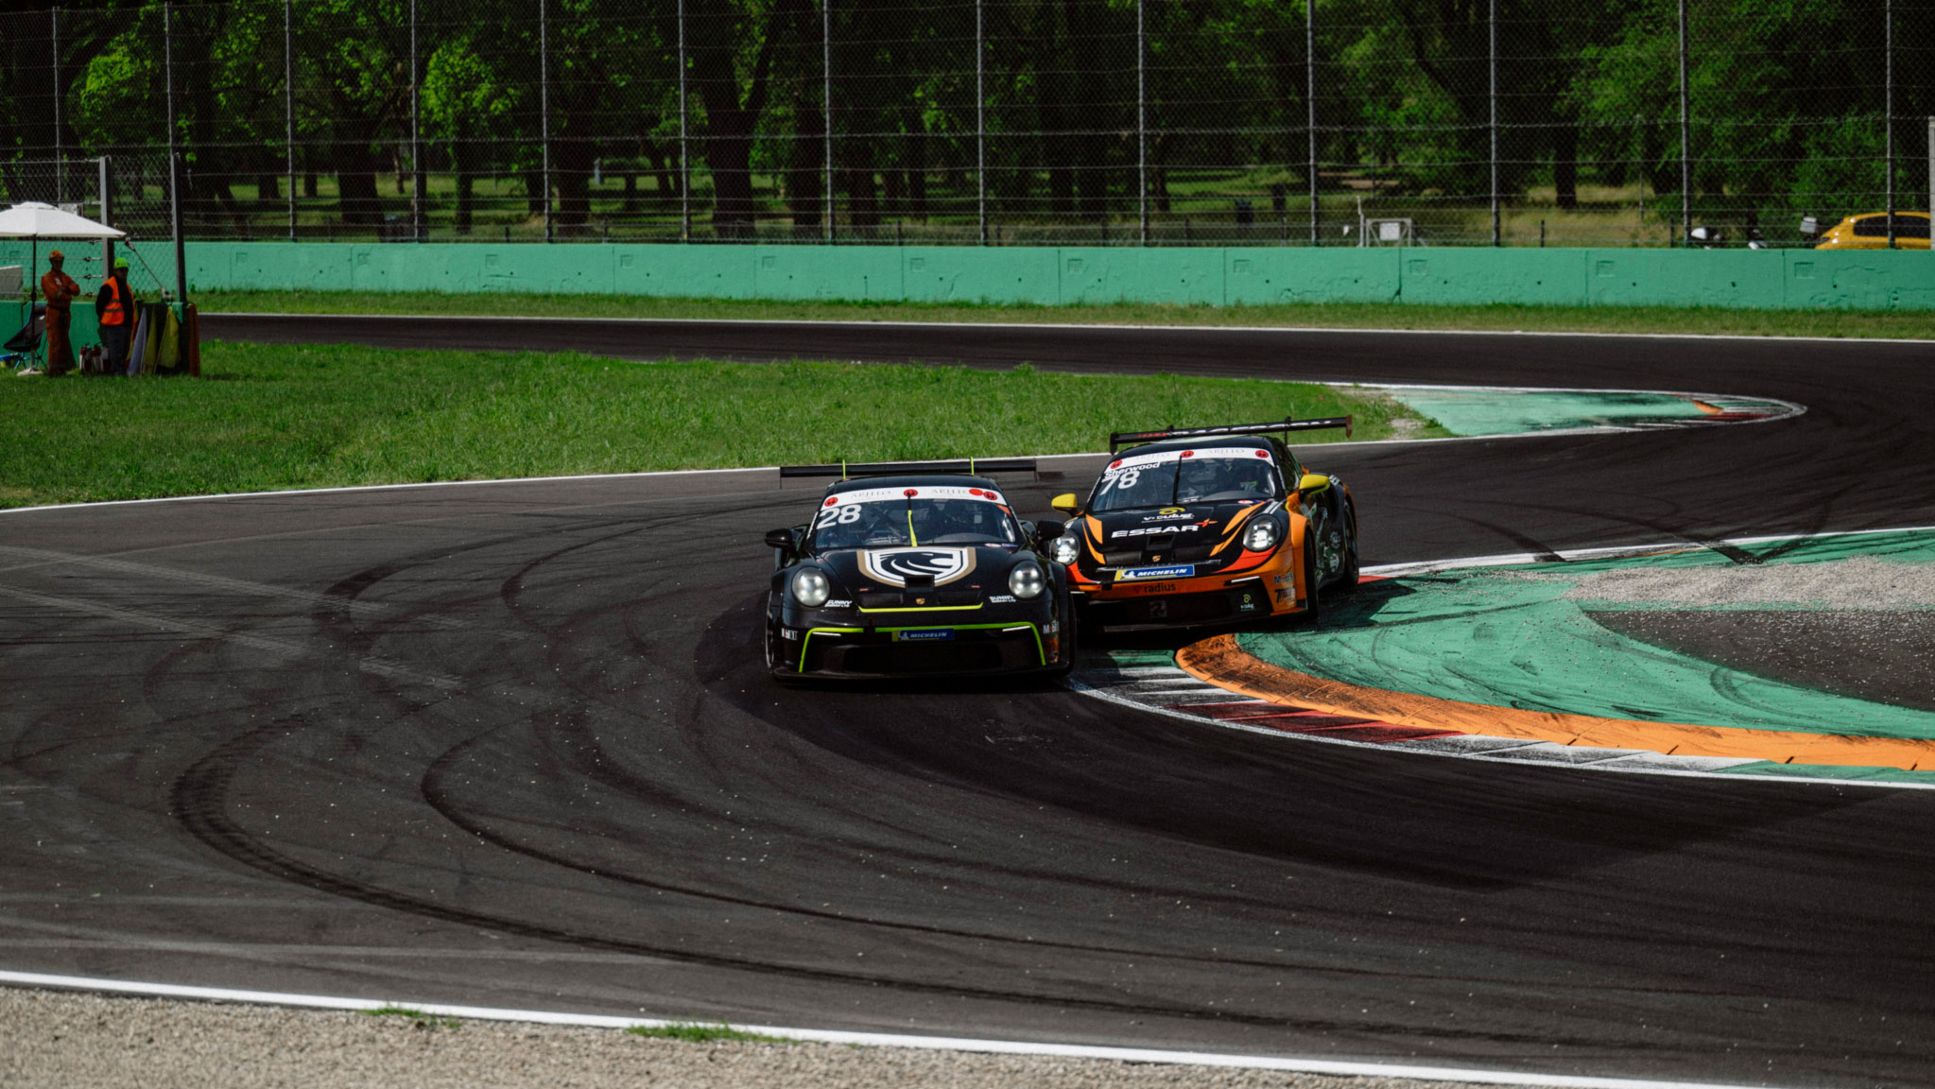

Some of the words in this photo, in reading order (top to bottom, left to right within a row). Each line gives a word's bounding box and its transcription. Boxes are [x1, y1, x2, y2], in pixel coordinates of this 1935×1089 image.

[1100, 470, 1140, 496] 78
[816, 504, 861, 529] 28
[1111, 525, 1199, 538] ESSAR
[1137, 568, 1188, 577] MICHELIN
[1143, 583, 1176, 593] radius
